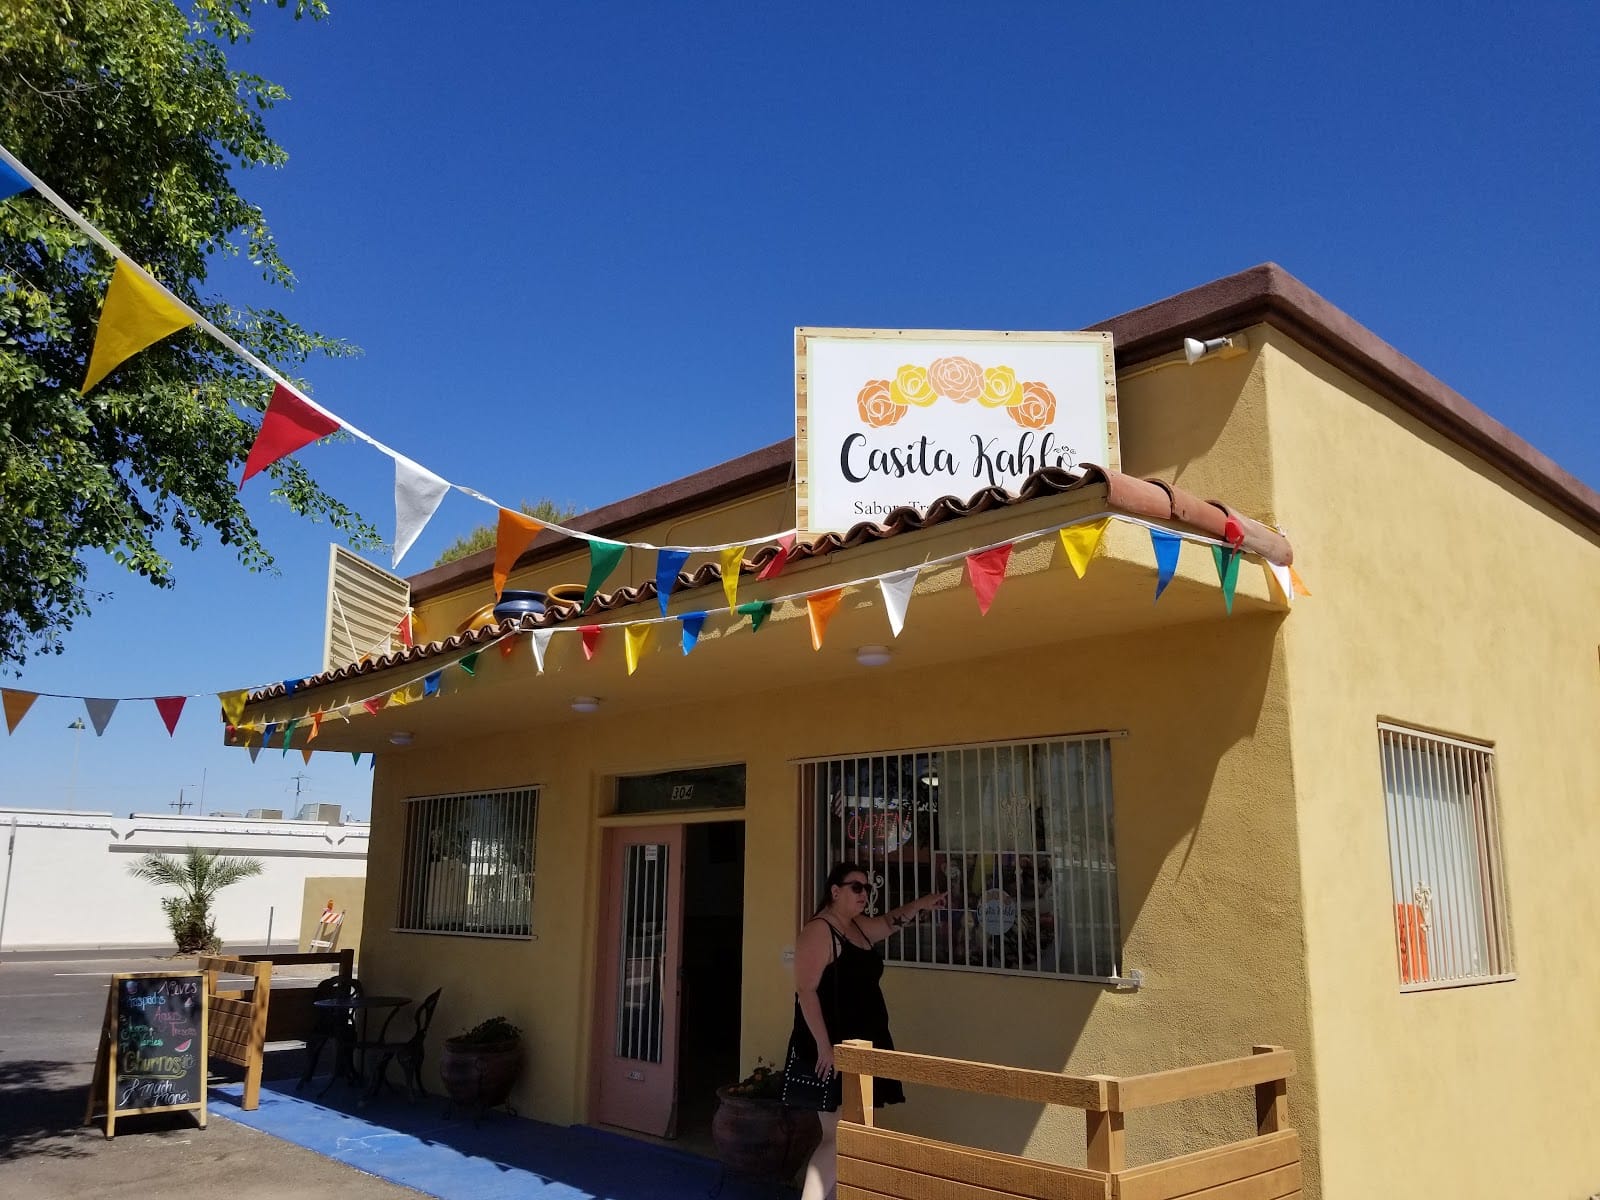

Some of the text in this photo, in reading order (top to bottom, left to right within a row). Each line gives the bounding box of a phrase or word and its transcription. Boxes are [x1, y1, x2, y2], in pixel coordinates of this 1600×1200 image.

[840, 431, 1077, 487] Casita Kahlo
[672, 784, 694, 800] 304
[847, 811, 911, 840] OPEN
[124, 1050, 182, 1073] Churros
